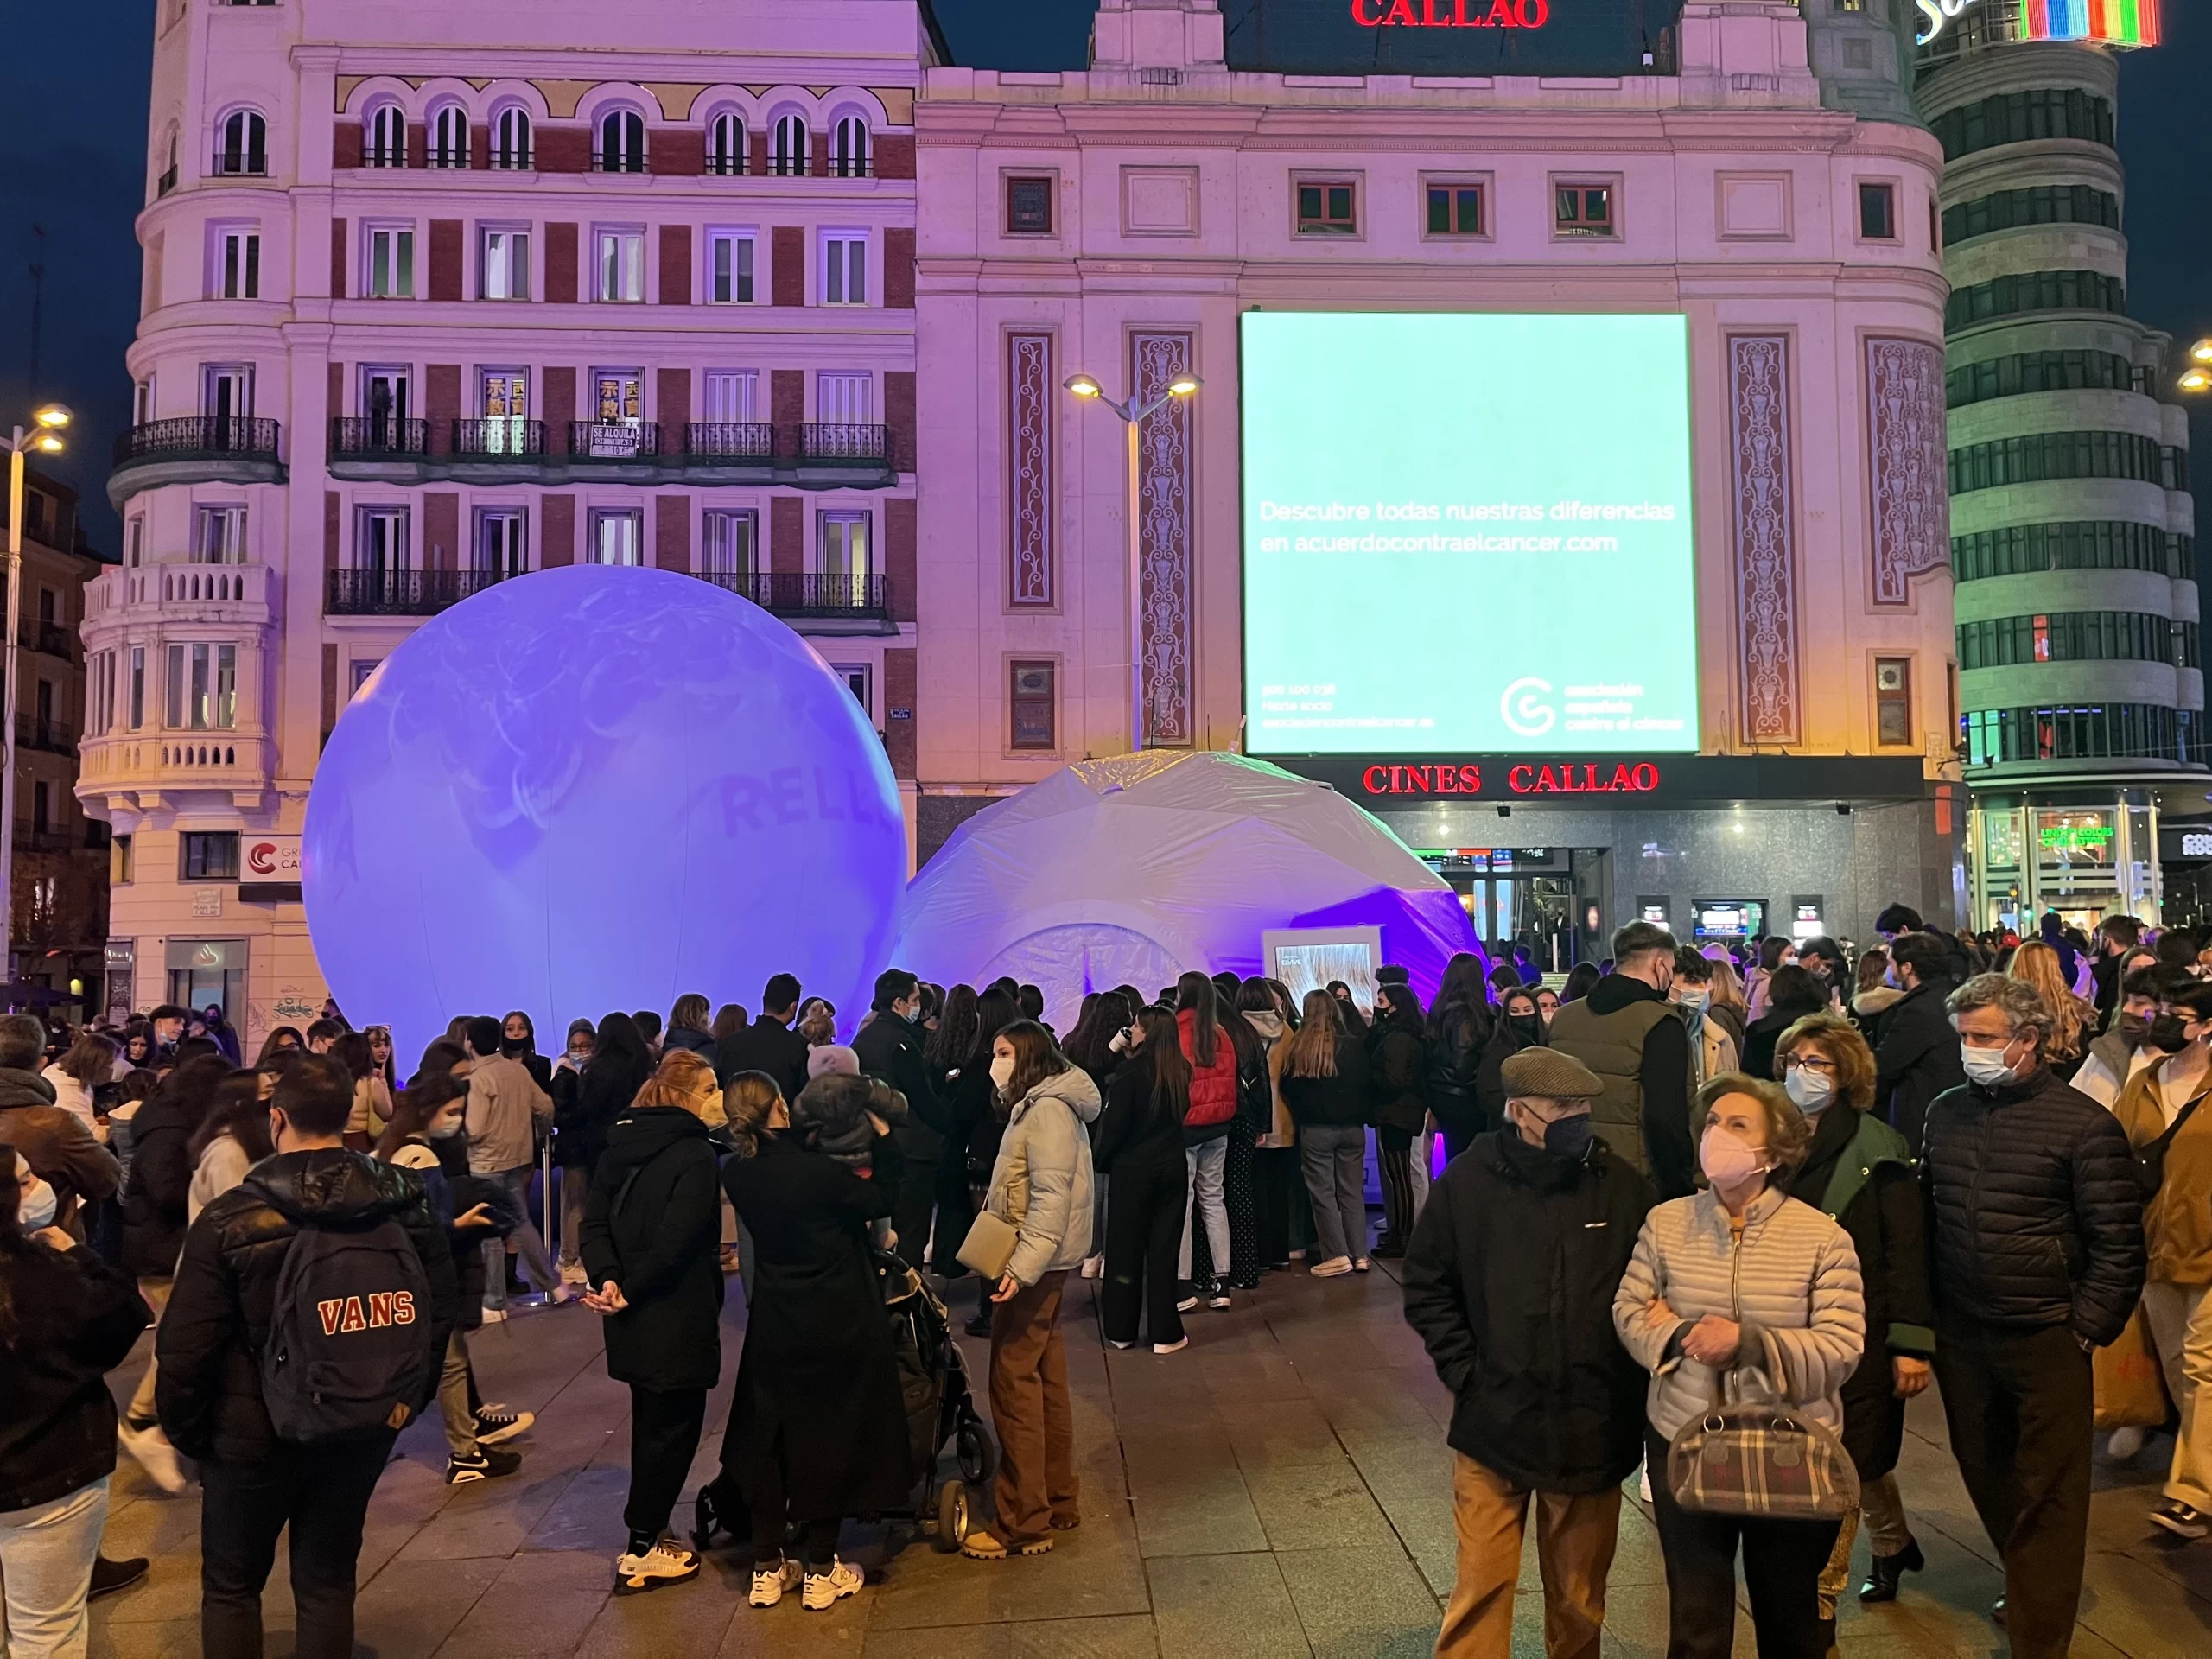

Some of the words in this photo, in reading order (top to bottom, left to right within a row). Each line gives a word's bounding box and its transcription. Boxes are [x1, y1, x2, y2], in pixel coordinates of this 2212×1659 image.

[1351, 0, 1548, 29] CALLAO
[594, 428, 603, 438] SE
[604, 428, 636, 440] ALQUILA
[1259, 500, 1371, 522] Descubre
[1376, 500, 1441, 522] todas
[1446, 501, 1545, 522] nuestras
[1548, 500, 1676, 522] diferencias
[1259, 536, 1290, 553] en
[1294, 531, 1618, 554] acuerdocontraelcancer.com
[1363, 765, 1482, 794] CINES
[1509, 762, 1661, 793] CALLAO
[317, 1290, 416, 1336] VANS
